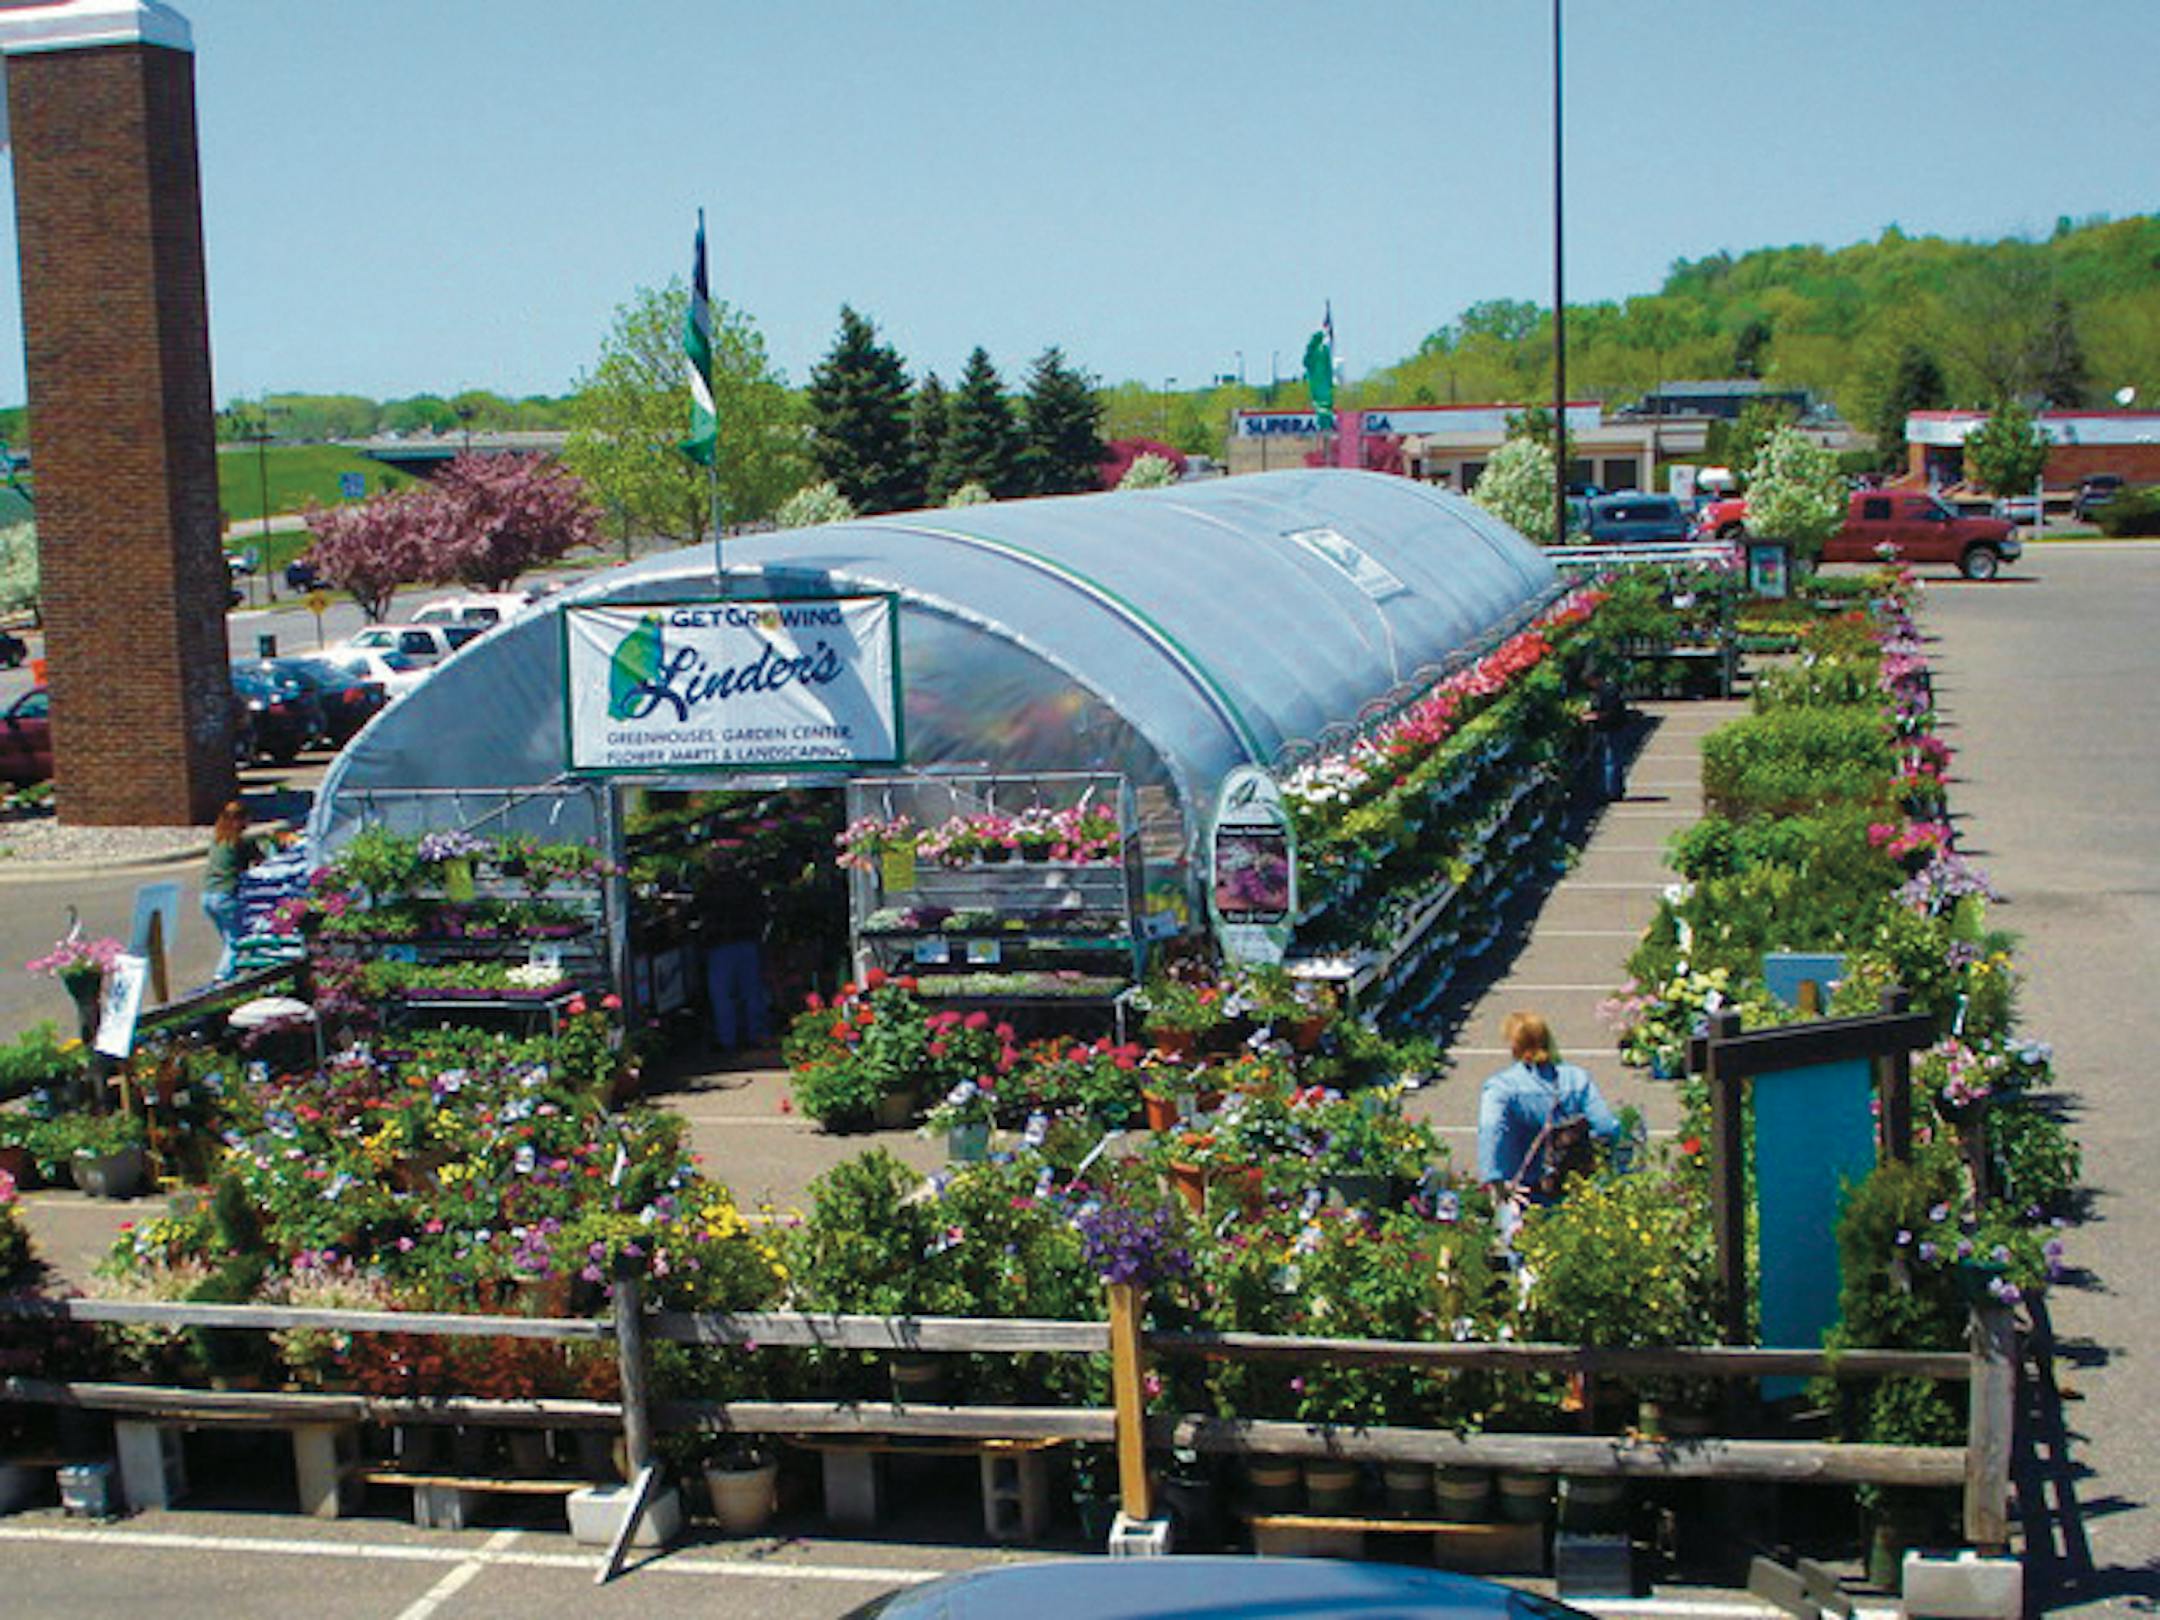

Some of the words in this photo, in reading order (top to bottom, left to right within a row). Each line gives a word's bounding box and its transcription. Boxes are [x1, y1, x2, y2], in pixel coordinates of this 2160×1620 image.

[671, 609, 723, 628] GET
[725, 606, 844, 630] GROWING
[620, 640, 844, 722] Linder's
[722, 728, 788, 742] GARDEN
[671, 748, 717, 761] MARTS
[723, 747, 733, 760] &
